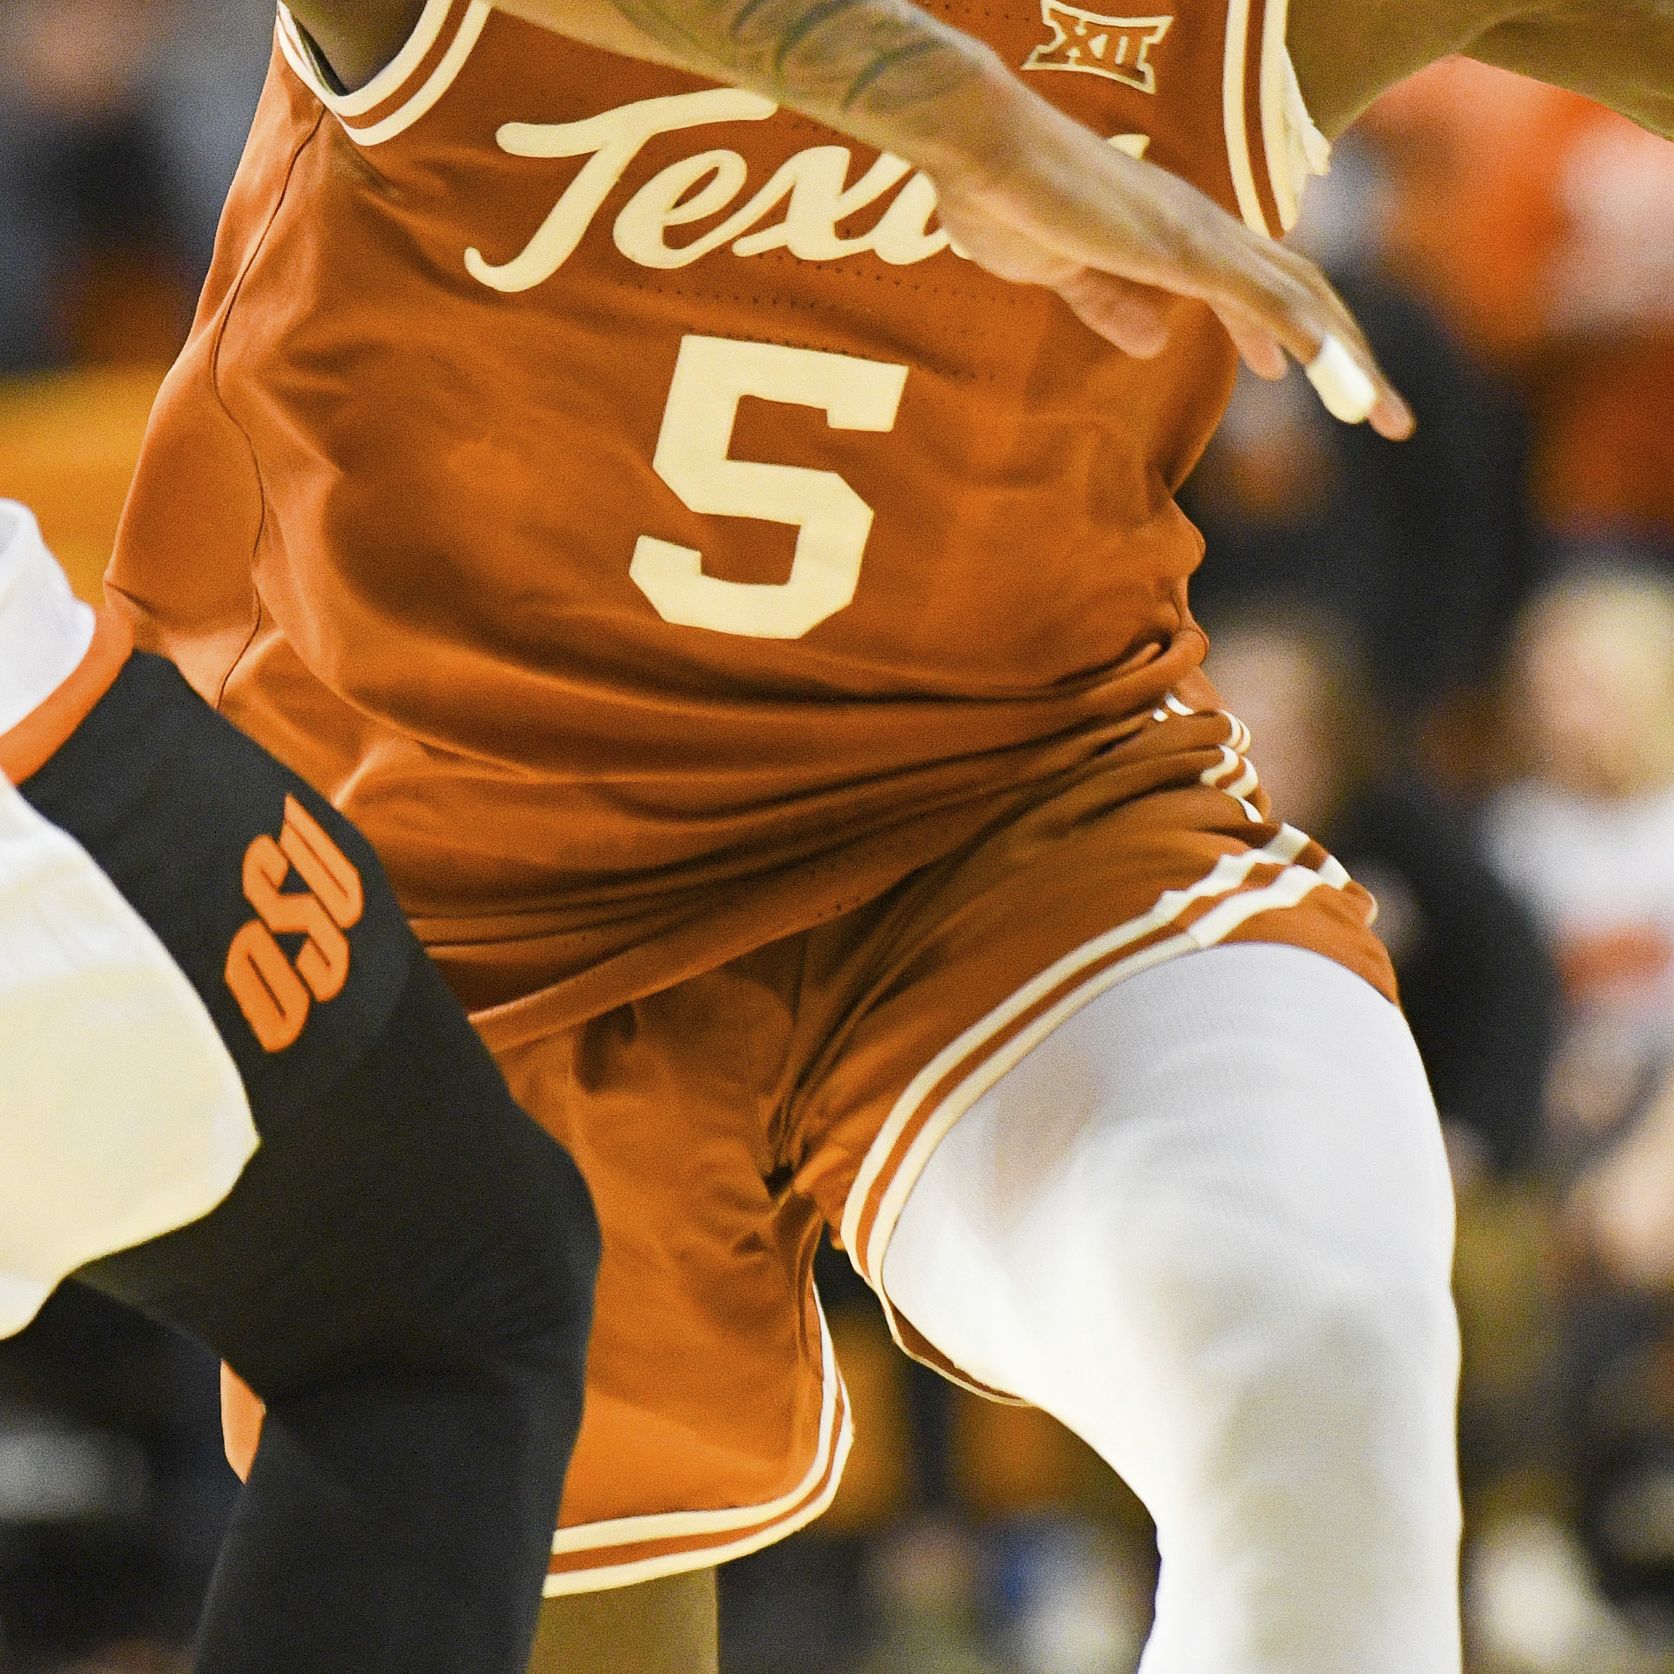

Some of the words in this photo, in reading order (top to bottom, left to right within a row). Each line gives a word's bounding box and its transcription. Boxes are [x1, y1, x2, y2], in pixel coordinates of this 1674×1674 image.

[464, 87, 1151, 292] Tex
[628, 334, 909, 640] 5
[224, 792, 365, 1052] OSU
